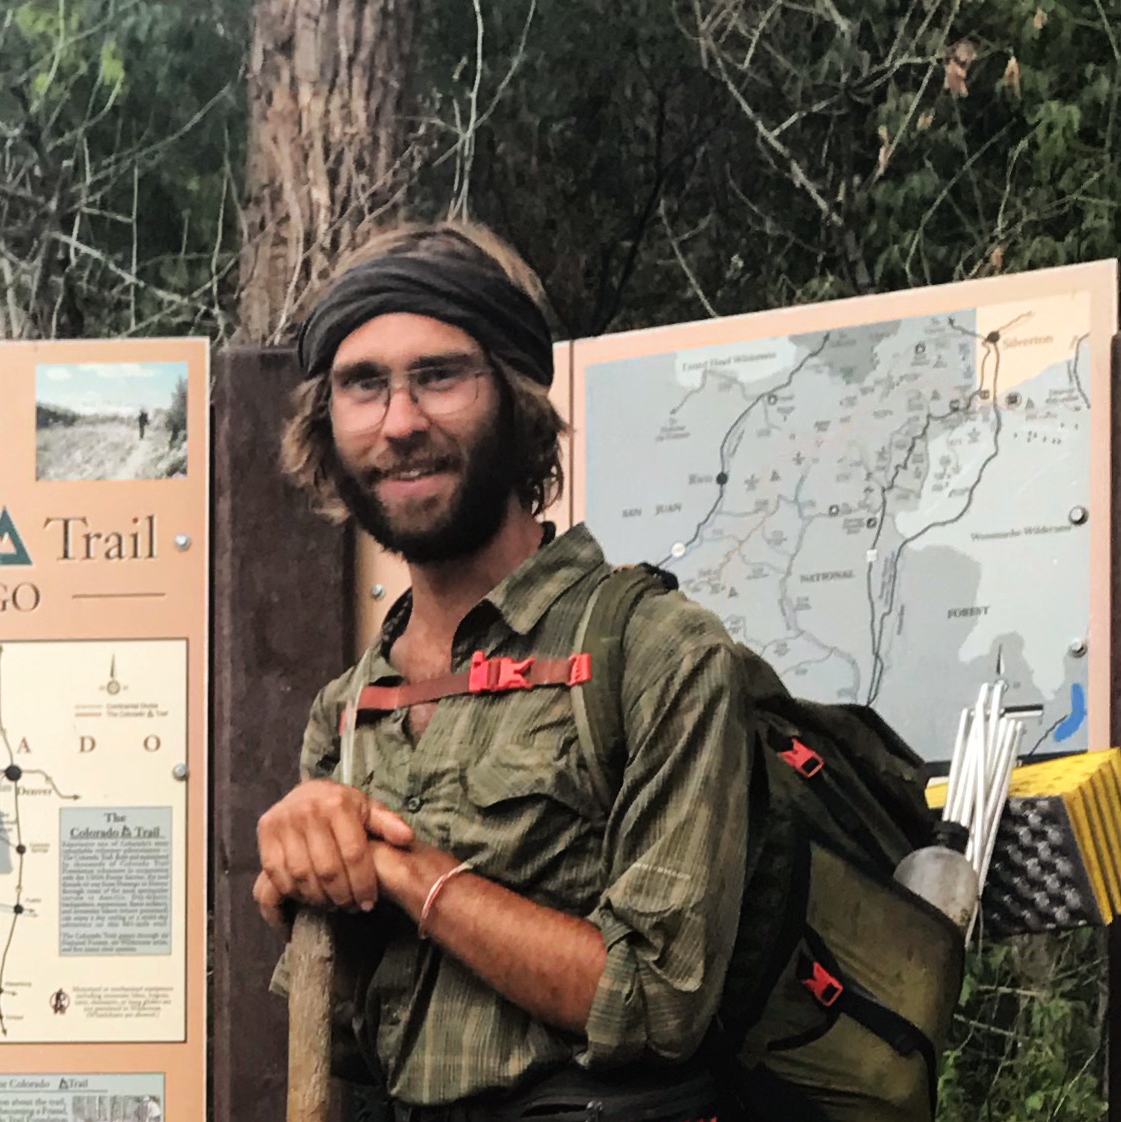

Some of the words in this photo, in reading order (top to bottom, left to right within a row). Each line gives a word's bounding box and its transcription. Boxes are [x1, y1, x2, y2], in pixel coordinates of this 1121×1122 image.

[43, 514, 159, 562] Trail
[948, 605, 991, 619] FOREST
[18, 786, 52, 797] Denver
[104, 812, 126, 823] The
[70, 827, 120, 839] Colorado
[134, 825, 161, 839] Trail
[9, 1078, 50, 1089] Colorado
[69, 1078, 88, 1089] Trail
